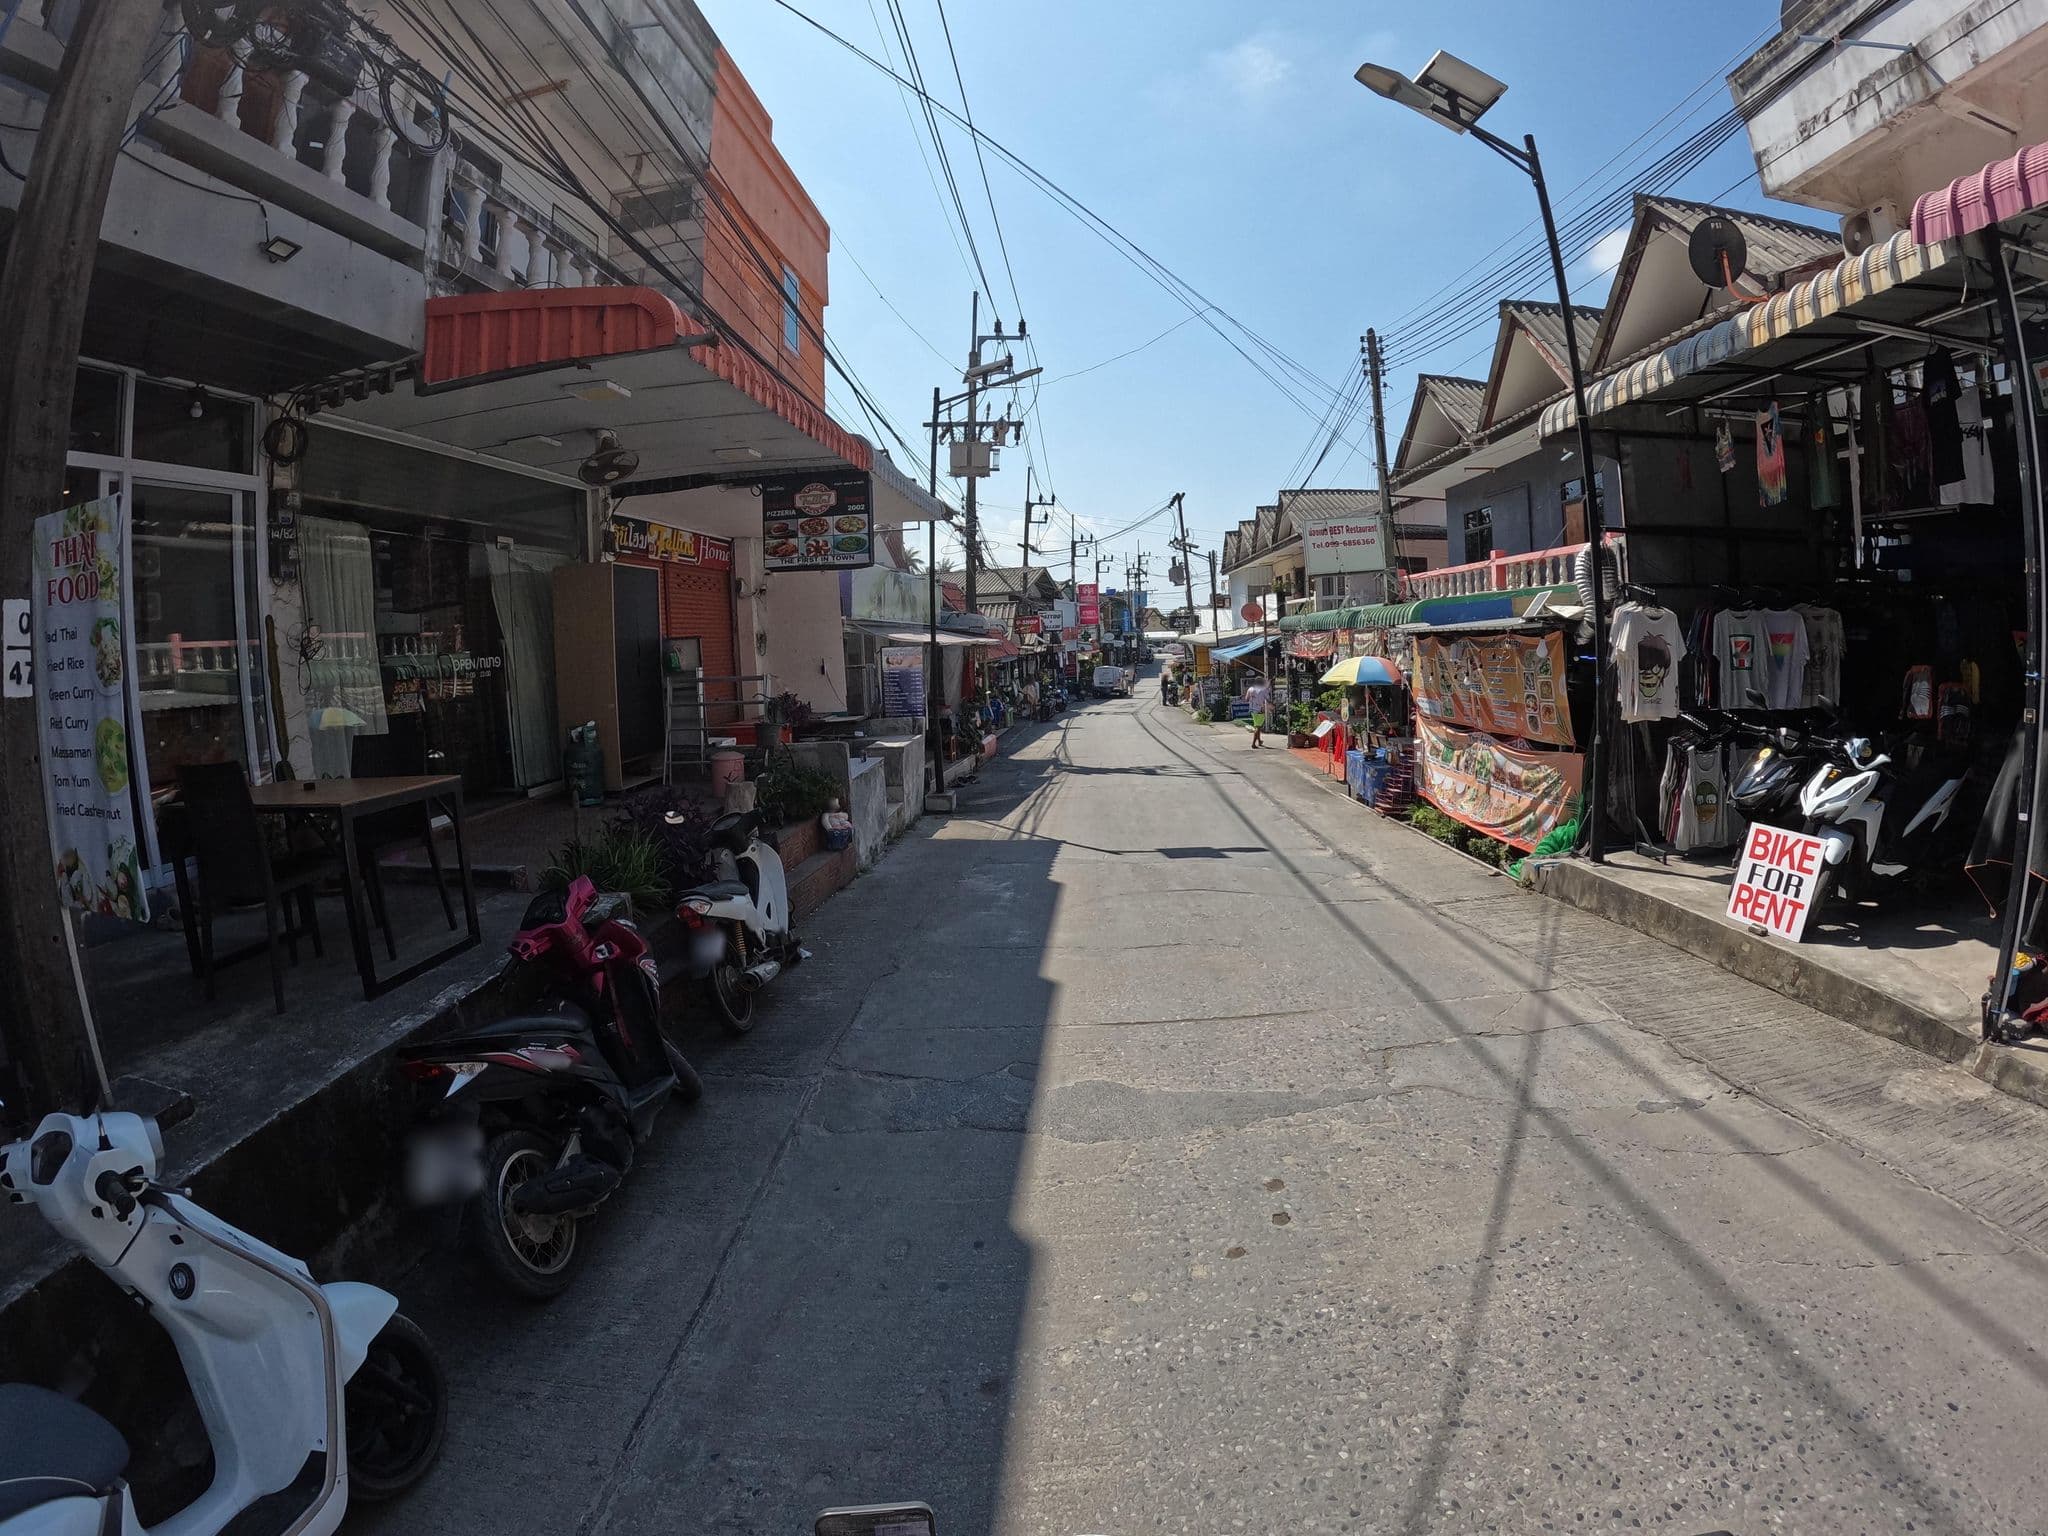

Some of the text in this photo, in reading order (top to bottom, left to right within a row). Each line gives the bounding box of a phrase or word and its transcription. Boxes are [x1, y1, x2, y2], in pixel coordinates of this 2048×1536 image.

[766, 509, 796, 518] PIZZERIA
[1329, 525, 1344, 536] BEST
[51, 531, 96, 568] THAI
[696, 535, 731, 566] Home
[832, 554, 856, 562] TOWN
[48, 571, 99, 607] FOOD
[60, 628, 78, 641] Thai
[67, 657, 85, 670] Rice
[72, 687, 95, 701] Curry
[65, 716, 89, 731] Curry
[53, 774, 90, 788] Tom Yum
[1748, 828, 1821, 876] BIKE
[1747, 864, 1804, 899] FOR
[1731, 883, 1805, 934] RENT
